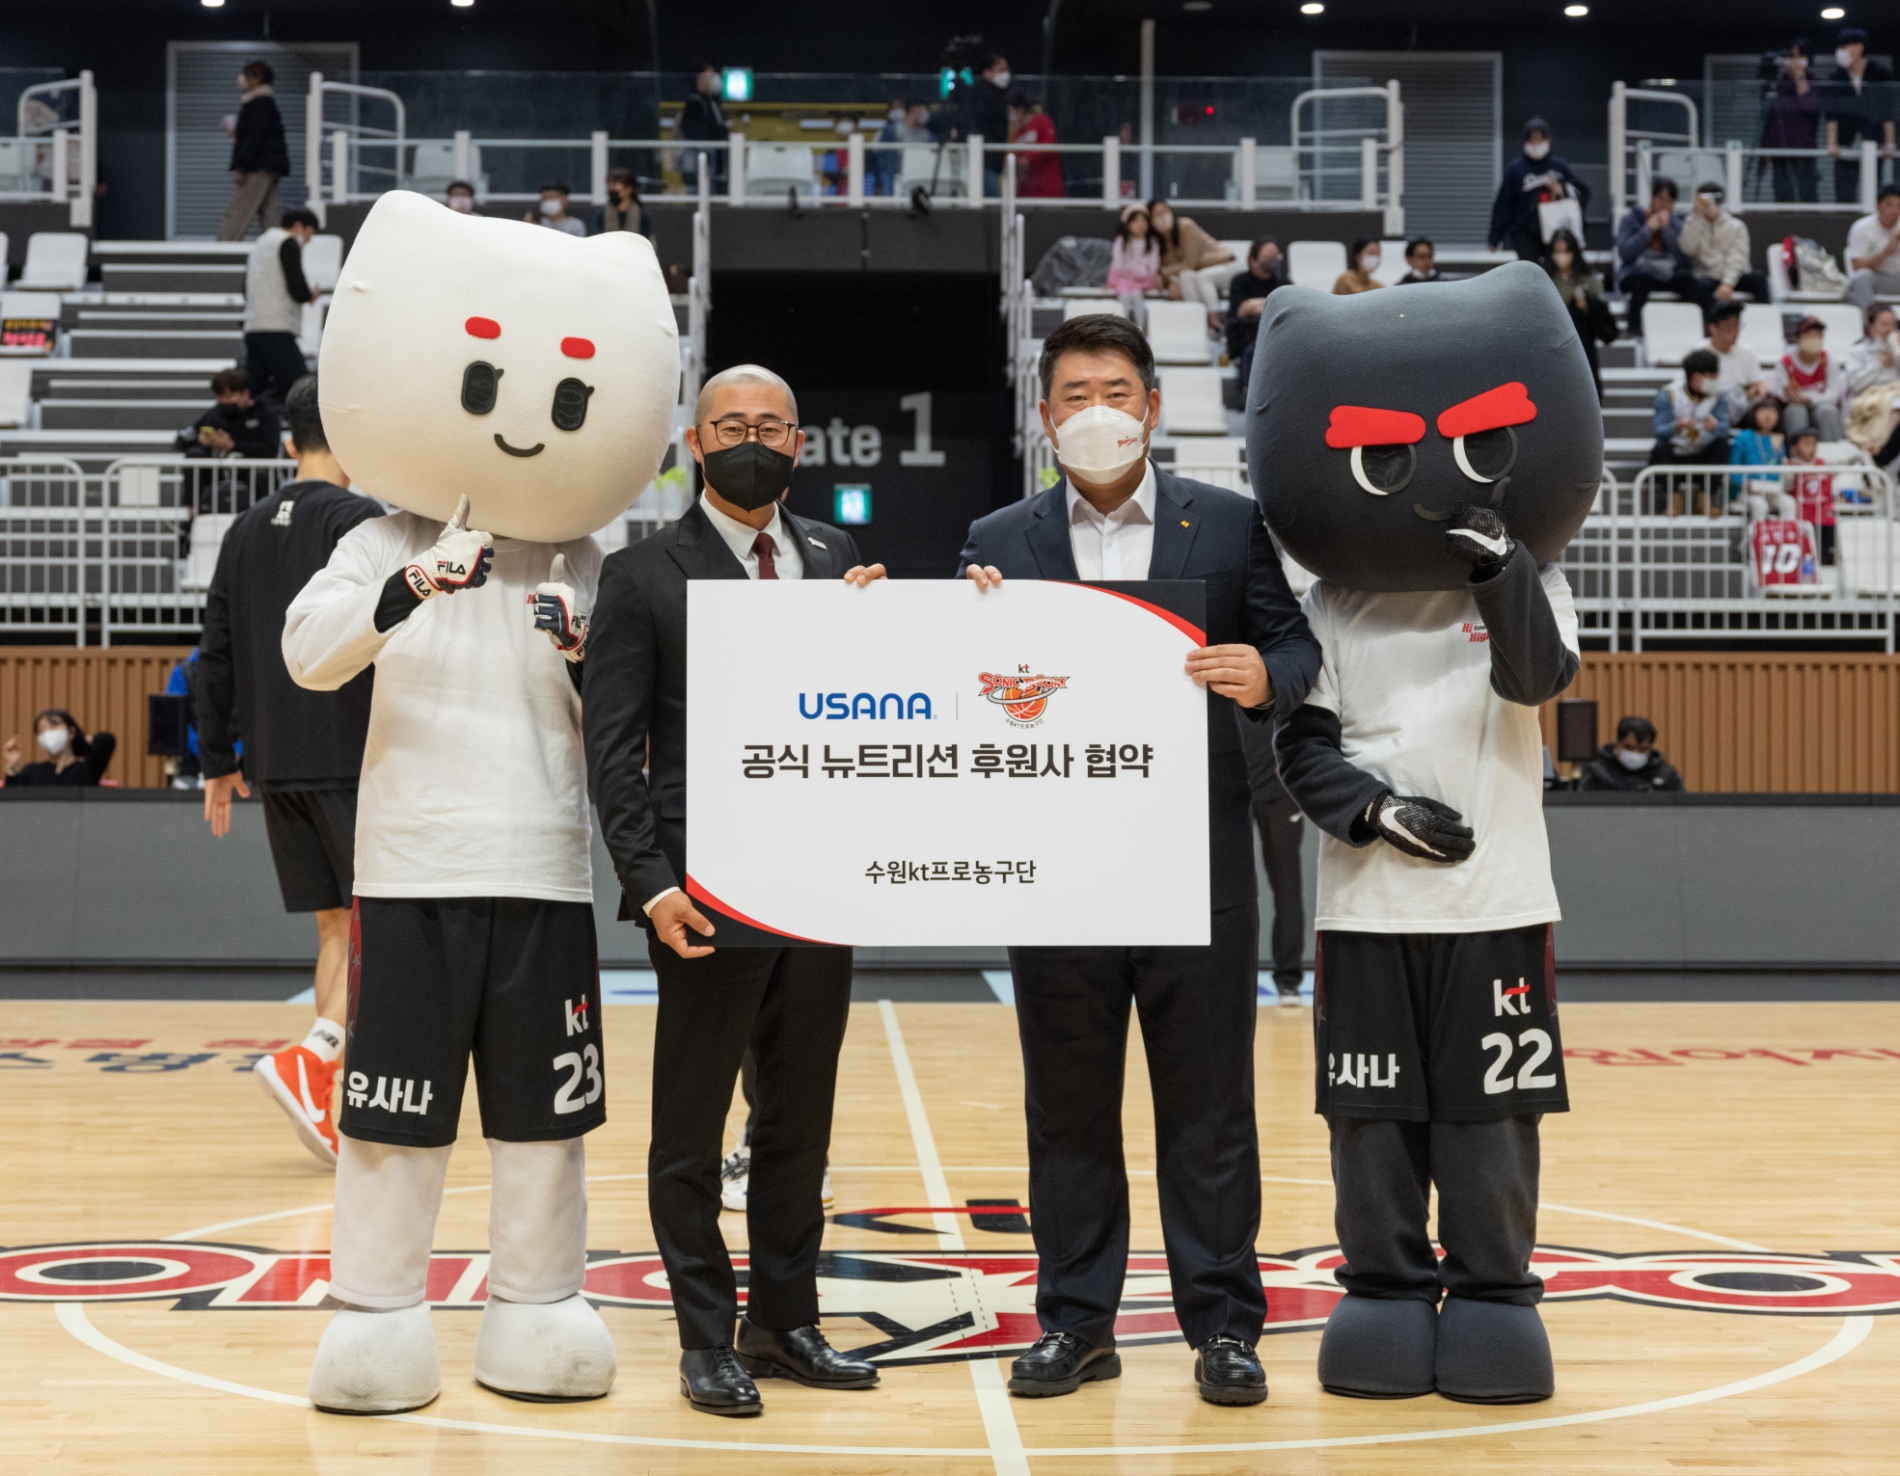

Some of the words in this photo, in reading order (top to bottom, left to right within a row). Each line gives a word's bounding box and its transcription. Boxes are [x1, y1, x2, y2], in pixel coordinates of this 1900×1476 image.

[799, 417, 882, 467] ate
[900, 392, 946, 467] 1
[437, 560, 466, 576] FILA
[1762, 543, 1801, 576] 10
[408, 569, 432, 597] FILA
[1018, 664, 1030, 673] kt
[799, 692, 932, 720] USANA
[741, 743, 809, 779] 공식
[821, 743, 959, 779] 뉴트리션
[970, 743, 1075, 779] 후원사
[1085, 743, 1154, 779] 협약
[865, 860, 1037, 885] 수원kt프로농구단
[1493, 977, 1531, 1017] kt
[565, 994, 589, 1037] kt
[553, 1043, 603, 1115] 23
[1481, 1028, 1557, 1095] 22
[347, 1071, 433, 1115] 유사나
